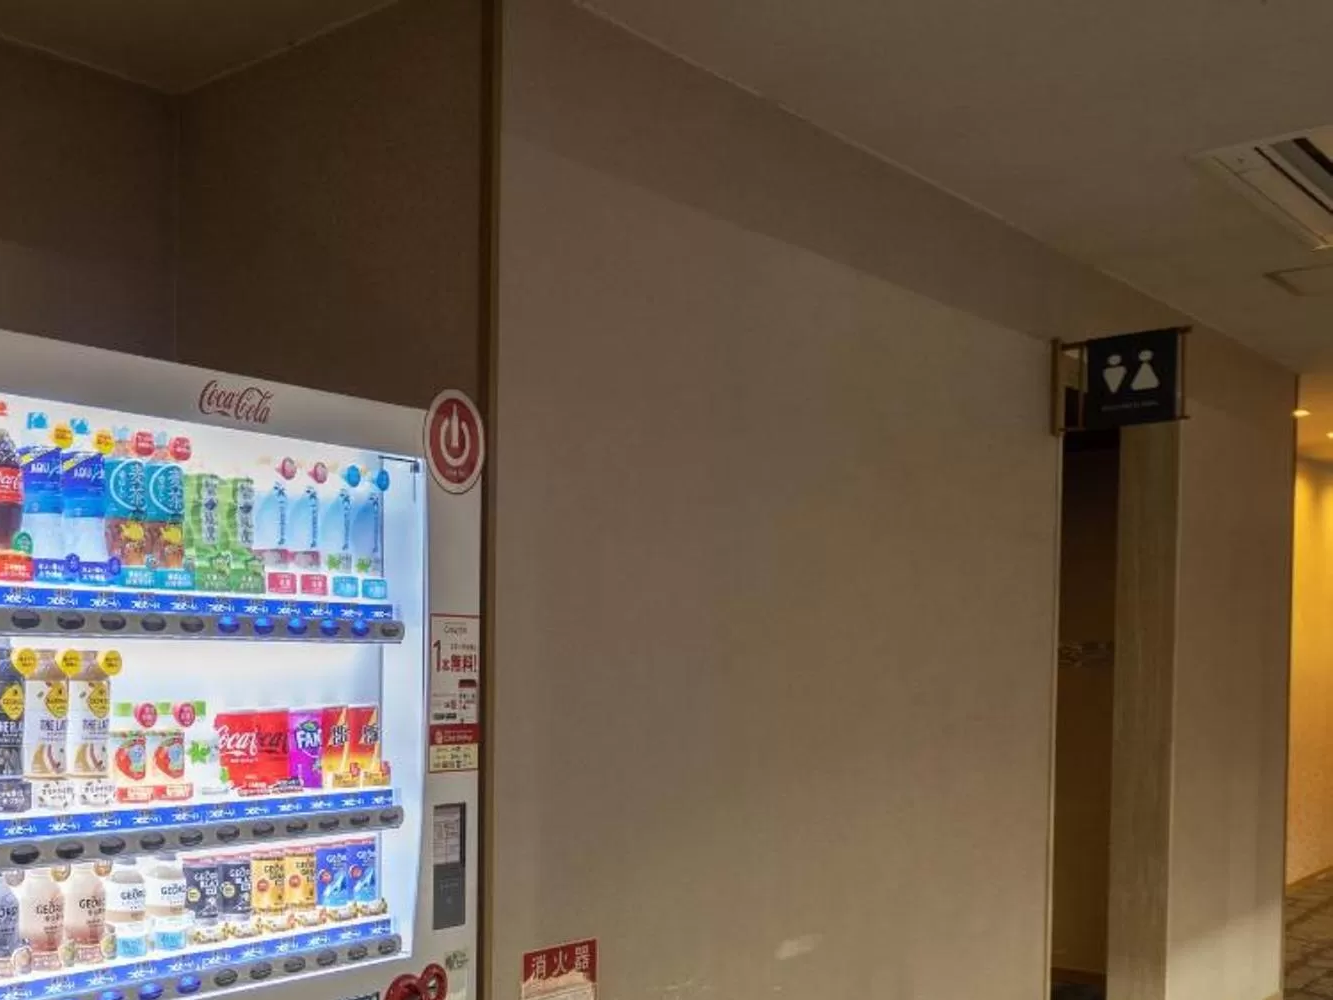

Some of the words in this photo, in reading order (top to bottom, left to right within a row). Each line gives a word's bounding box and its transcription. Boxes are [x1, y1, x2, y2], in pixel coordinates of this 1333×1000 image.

[198, 379, 274, 424] Coca-Cola
[296, 729, 322, 749] FAN
[532, 944, 591, 979] 消火器
